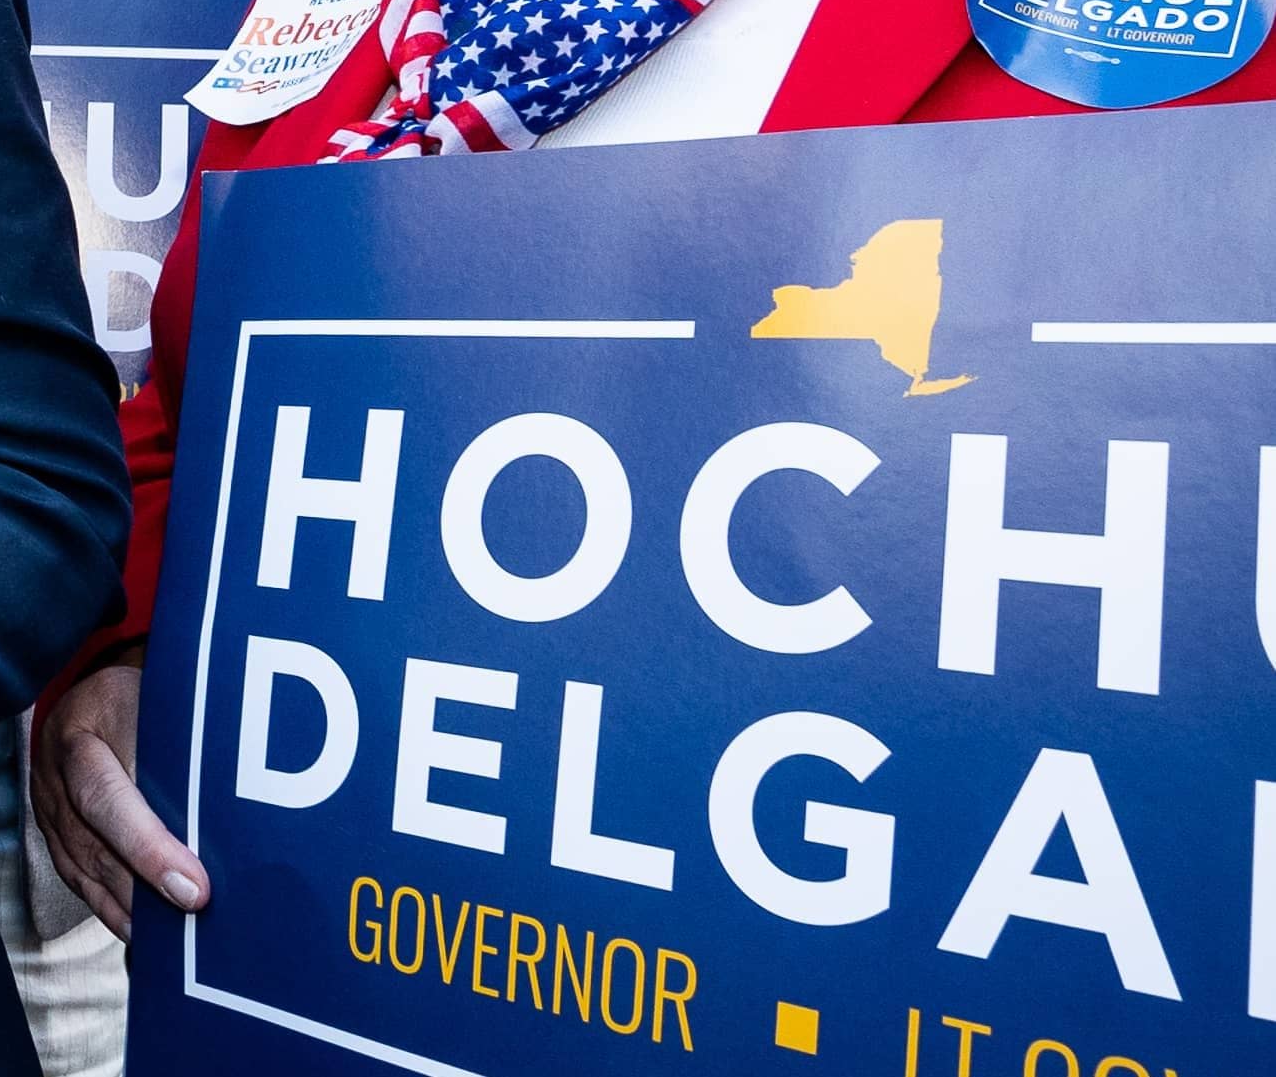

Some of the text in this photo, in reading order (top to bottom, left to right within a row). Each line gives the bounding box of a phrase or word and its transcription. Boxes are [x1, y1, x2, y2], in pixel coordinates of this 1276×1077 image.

[238, 3, 382, 46] Rebecca
[1014, 0, 1195, 45] GOVERNOR LT GOVERNOR
[256, 404, 1276, 696] HOCH
[235, 634, 1276, 1023] DELGA
[347, 877, 698, 1052] GOVERNOR
